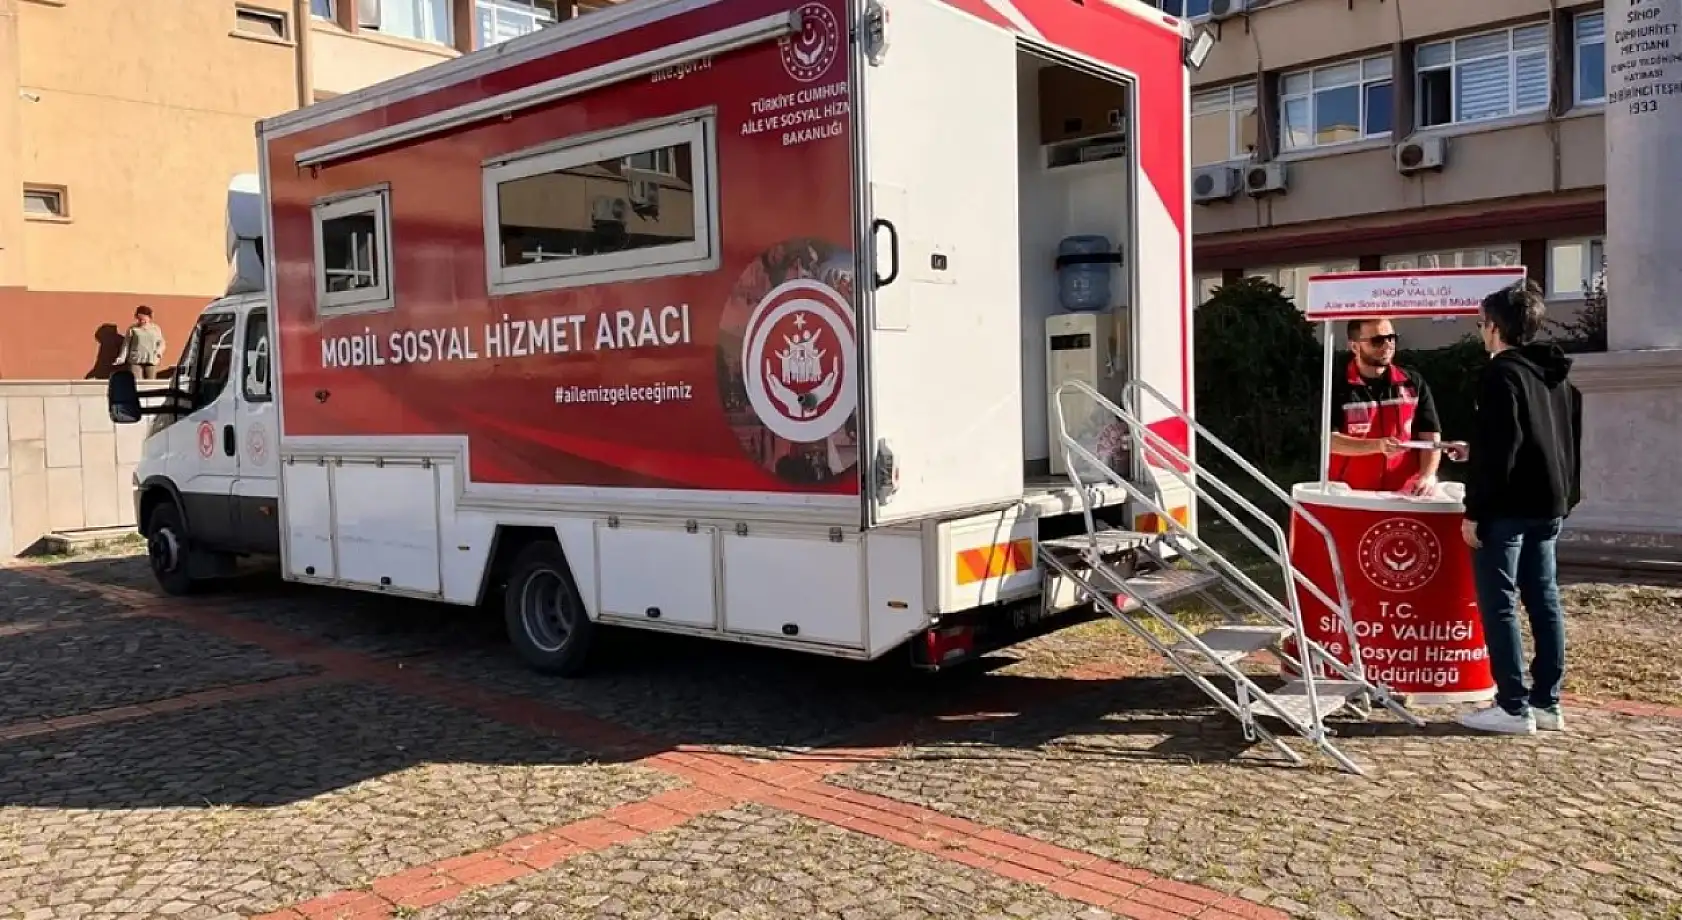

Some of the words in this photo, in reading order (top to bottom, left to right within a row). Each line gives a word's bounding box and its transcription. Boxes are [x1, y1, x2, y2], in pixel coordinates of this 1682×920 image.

[751, 94, 795, 114] TÜRKİYE
[1629, 100, 1657, 115] 1933
[741, 118, 763, 135] AİLE
[765, 116, 779, 130] VE
[781, 107, 822, 127] SOSYAL
[782, 120, 843, 146] BAKANLIĞI
[1371, 288, 1405, 298] SİNOP
[321, 326, 386, 369] MOBİL
[389, 326, 479, 365] SOSYAL
[484, 313, 586, 359] HİZMET
[595, 304, 691, 351] ARACI
[554, 381, 693, 406] #ailemizgeleceğimiz
[1379, 601, 1419, 619] T.C.
[1391, 620, 1474, 642] VALİLİĞİ
[1352, 643, 1418, 663] osyal
[1364, 664, 1461, 688] üdürlüğü
